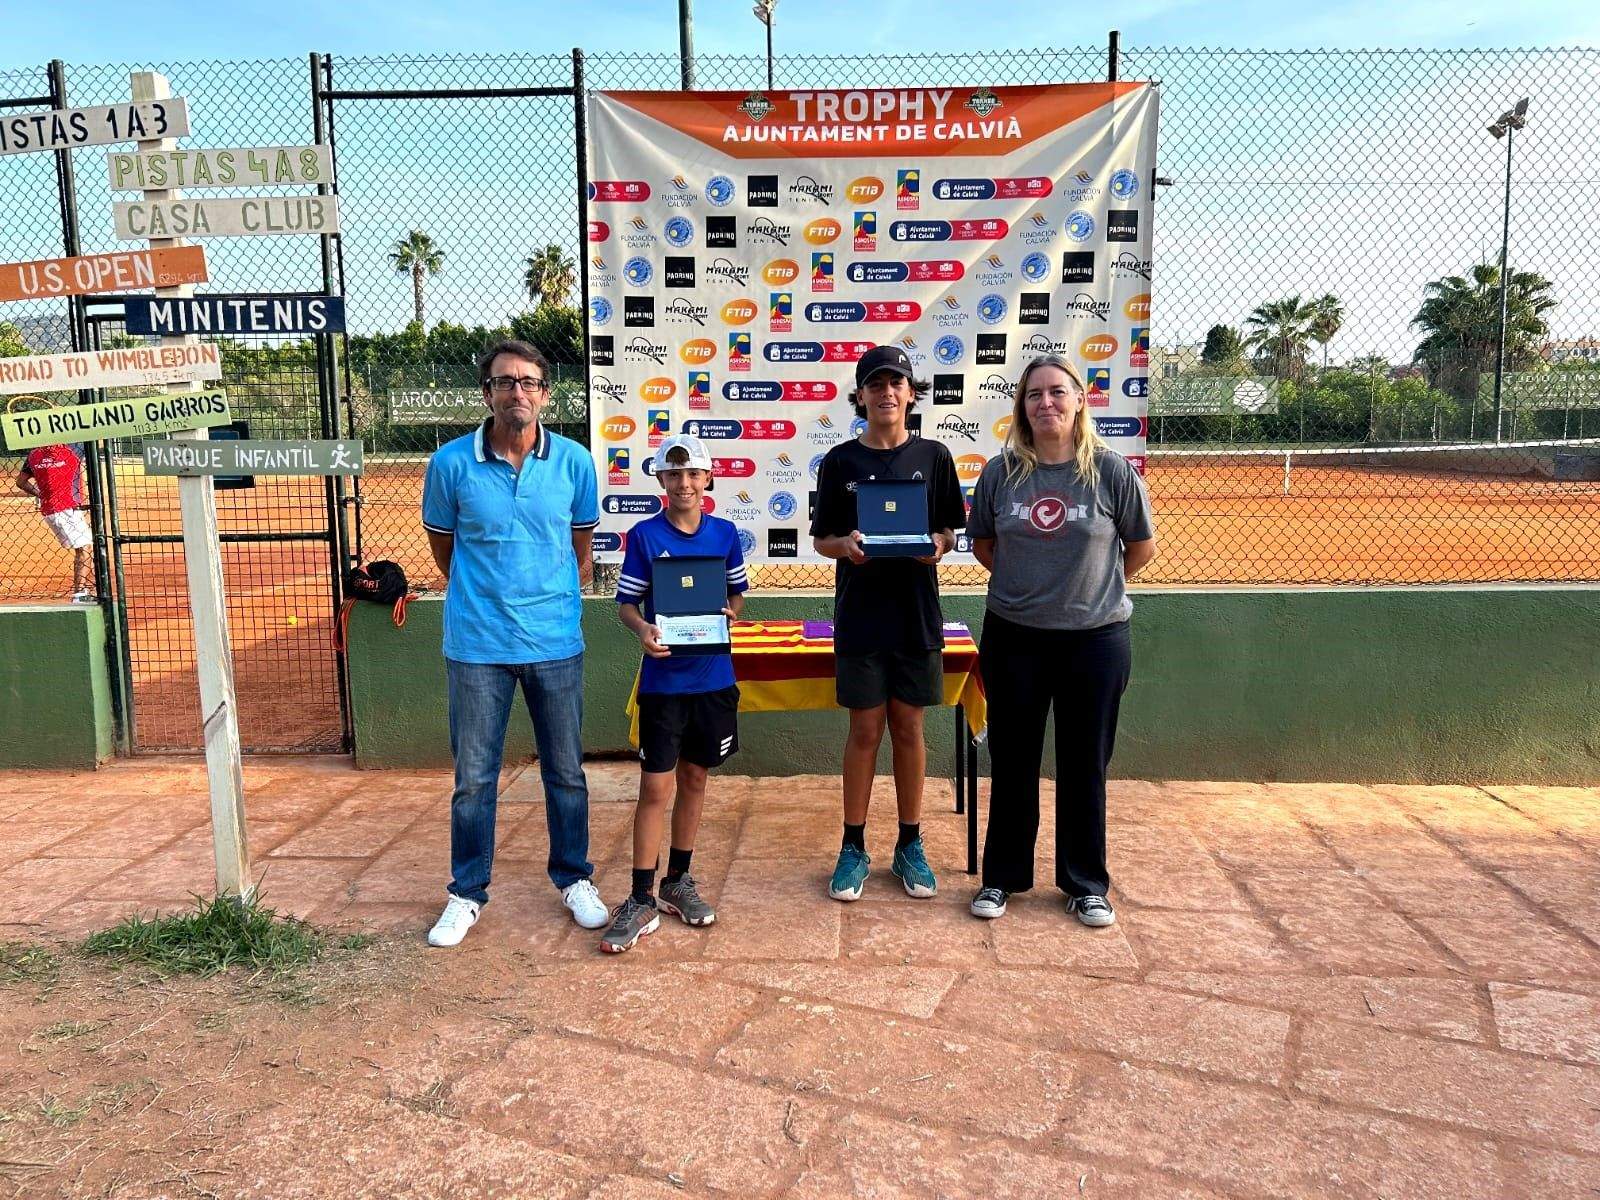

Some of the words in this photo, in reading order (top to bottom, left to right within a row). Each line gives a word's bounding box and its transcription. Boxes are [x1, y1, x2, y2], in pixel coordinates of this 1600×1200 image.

[789, 90, 953, 122] TROPHY
[0, 112, 88, 151] ISTAS
[722, 124, 889, 142] AJUNTAMENT
[895, 124, 927, 140] DE
[933, 117, 1022, 139] CALVIÀ
[114, 151, 236, 187] PISTAS
[749, 191, 777, 199] PADRINO
[851, 186, 879, 196] FTIB
[127, 202, 211, 235] CASA
[242, 199, 325, 232] CLUB
[809, 226, 836, 236] FTIB
[1109, 226, 1136, 235] PADRINO
[707, 232, 735, 240] PADRINO
[74, 253, 156, 290] OPEN
[666, 272, 694, 280] PADRINO
[767, 268, 794, 277] FTIB
[149, 299, 328, 332] MINITENIS
[626, 312, 654, 320] PADRINO
[725, 307, 752, 317] FTIB
[1020, 308, 1048, 317] PADRINO
[685, 346, 711, 356] FTIB
[977, 349, 1005, 357] PADRINO
[1085, 343, 1113, 353] FTIB
[0, 358, 53, 383] ROAD
[62, 356, 89, 377] TO
[96, 343, 218, 372] WIMBLEDON
[644, 385, 671, 394] FTIB
[979, 383, 1017, 391] MAKAM
[935, 389, 962, 398] PADRINO
[391, 390, 465, 408] LAROCCA
[13, 416, 41, 438] TO
[48, 403, 136, 434] ROLAND
[145, 393, 226, 422] GARROS
[604, 423, 631, 432] FTIB
[147, 446, 222, 469] PARQUE
[769, 543, 796, 551] PADRINO
